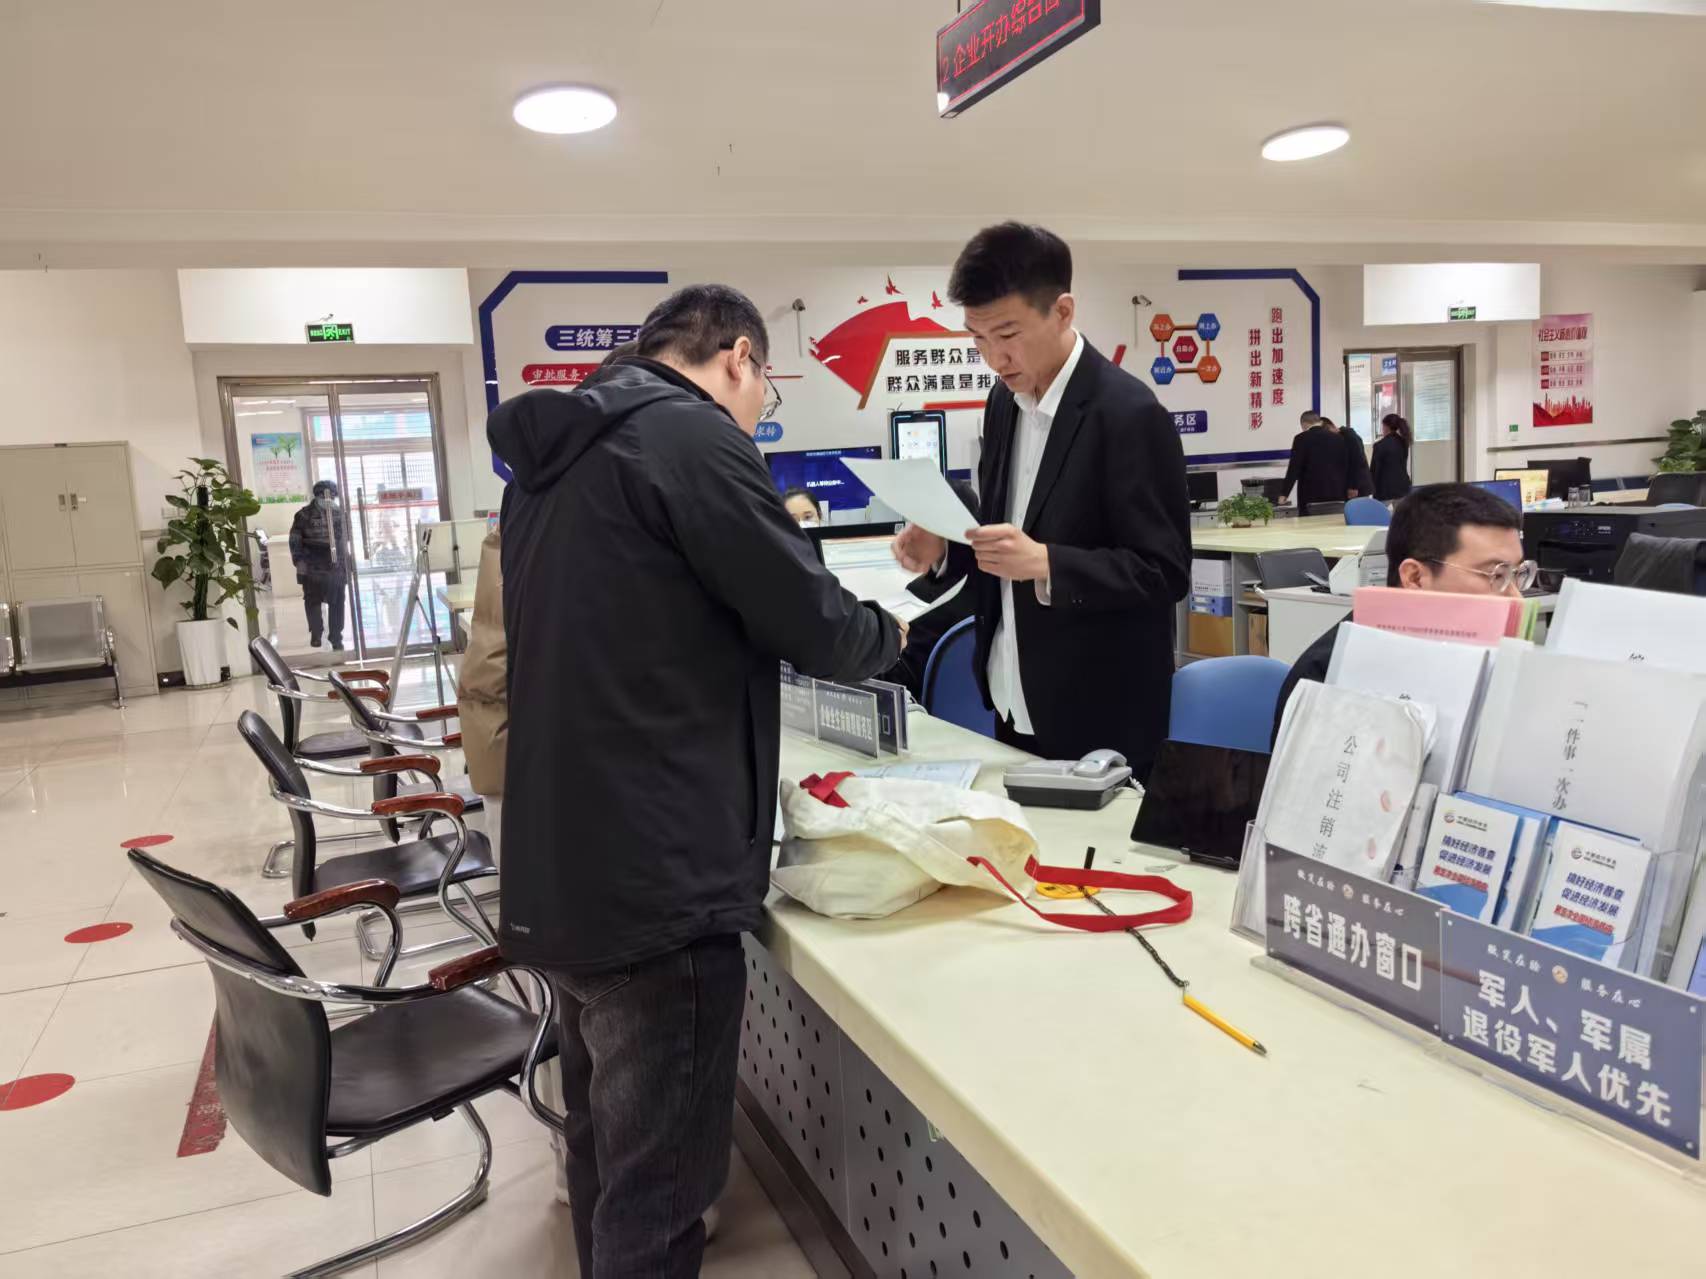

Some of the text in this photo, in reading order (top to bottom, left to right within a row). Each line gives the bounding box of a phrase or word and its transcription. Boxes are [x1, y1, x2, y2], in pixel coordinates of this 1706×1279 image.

[887, 373, 1000, 392] 群众满意是我
[1249, 328, 1263, 429] 拼出新精彩
[1271, 307, 1284, 405] 跑出加速度
[1561, 888, 1620, 917] 促进经济发展
[1566, 872, 1624, 901] 搞好经济普查
[1284, 894, 1421, 991] 跨省通办窗口
[1463, 1005, 1672, 1128] 退役军人优先
[1478, 968, 1651, 1071] 军人、军属
